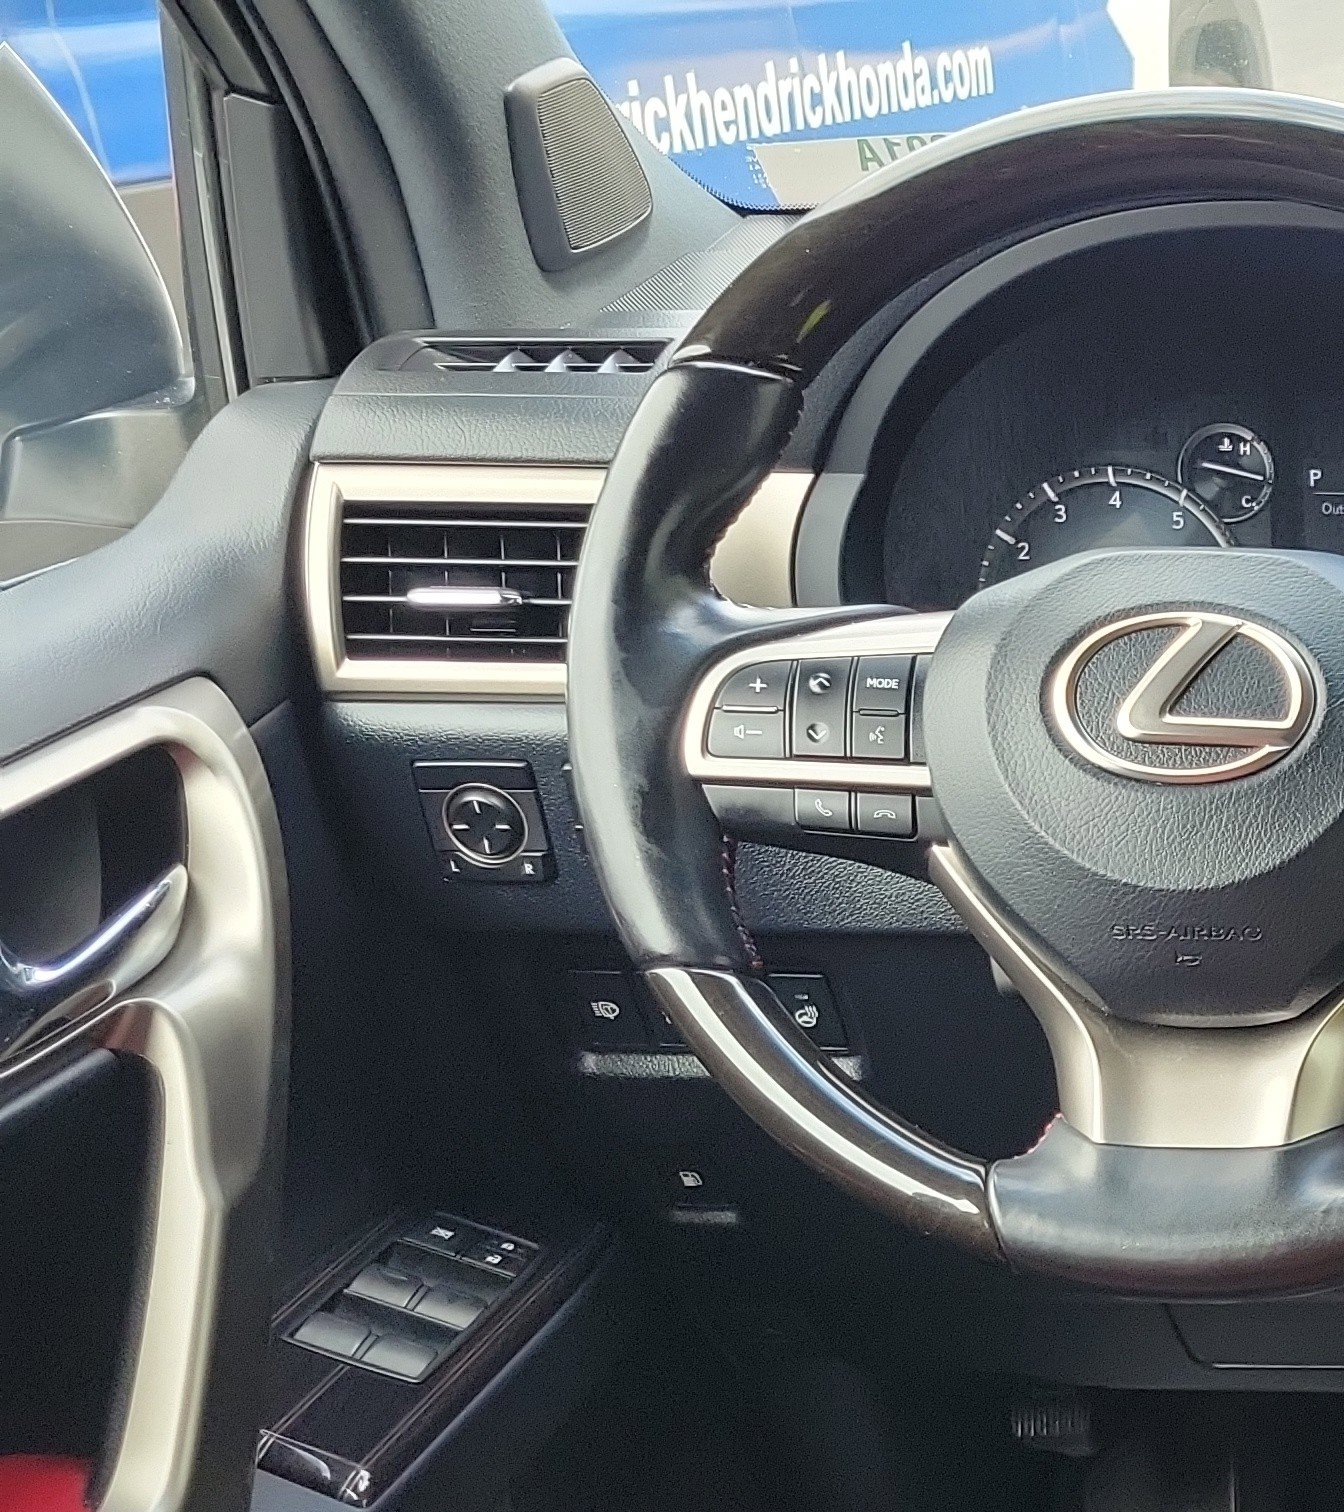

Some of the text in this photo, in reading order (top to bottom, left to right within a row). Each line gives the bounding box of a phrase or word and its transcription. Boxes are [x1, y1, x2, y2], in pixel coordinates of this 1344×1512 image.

[1239, 442, 1250, 456] H
[1309, 469, 1322, 487] P
[1109, 490, 1122, 509] 4
[1241, 495, 1252, 508] C
[1054, 504, 1067, 523] 3
[1172, 511, 1184, 530] 5
[1017, 542, 1030, 561] 2
[866, 677, 900, 690] MODE
[450, 859, 460, 873] L
[524, 862, 536, 875] R
